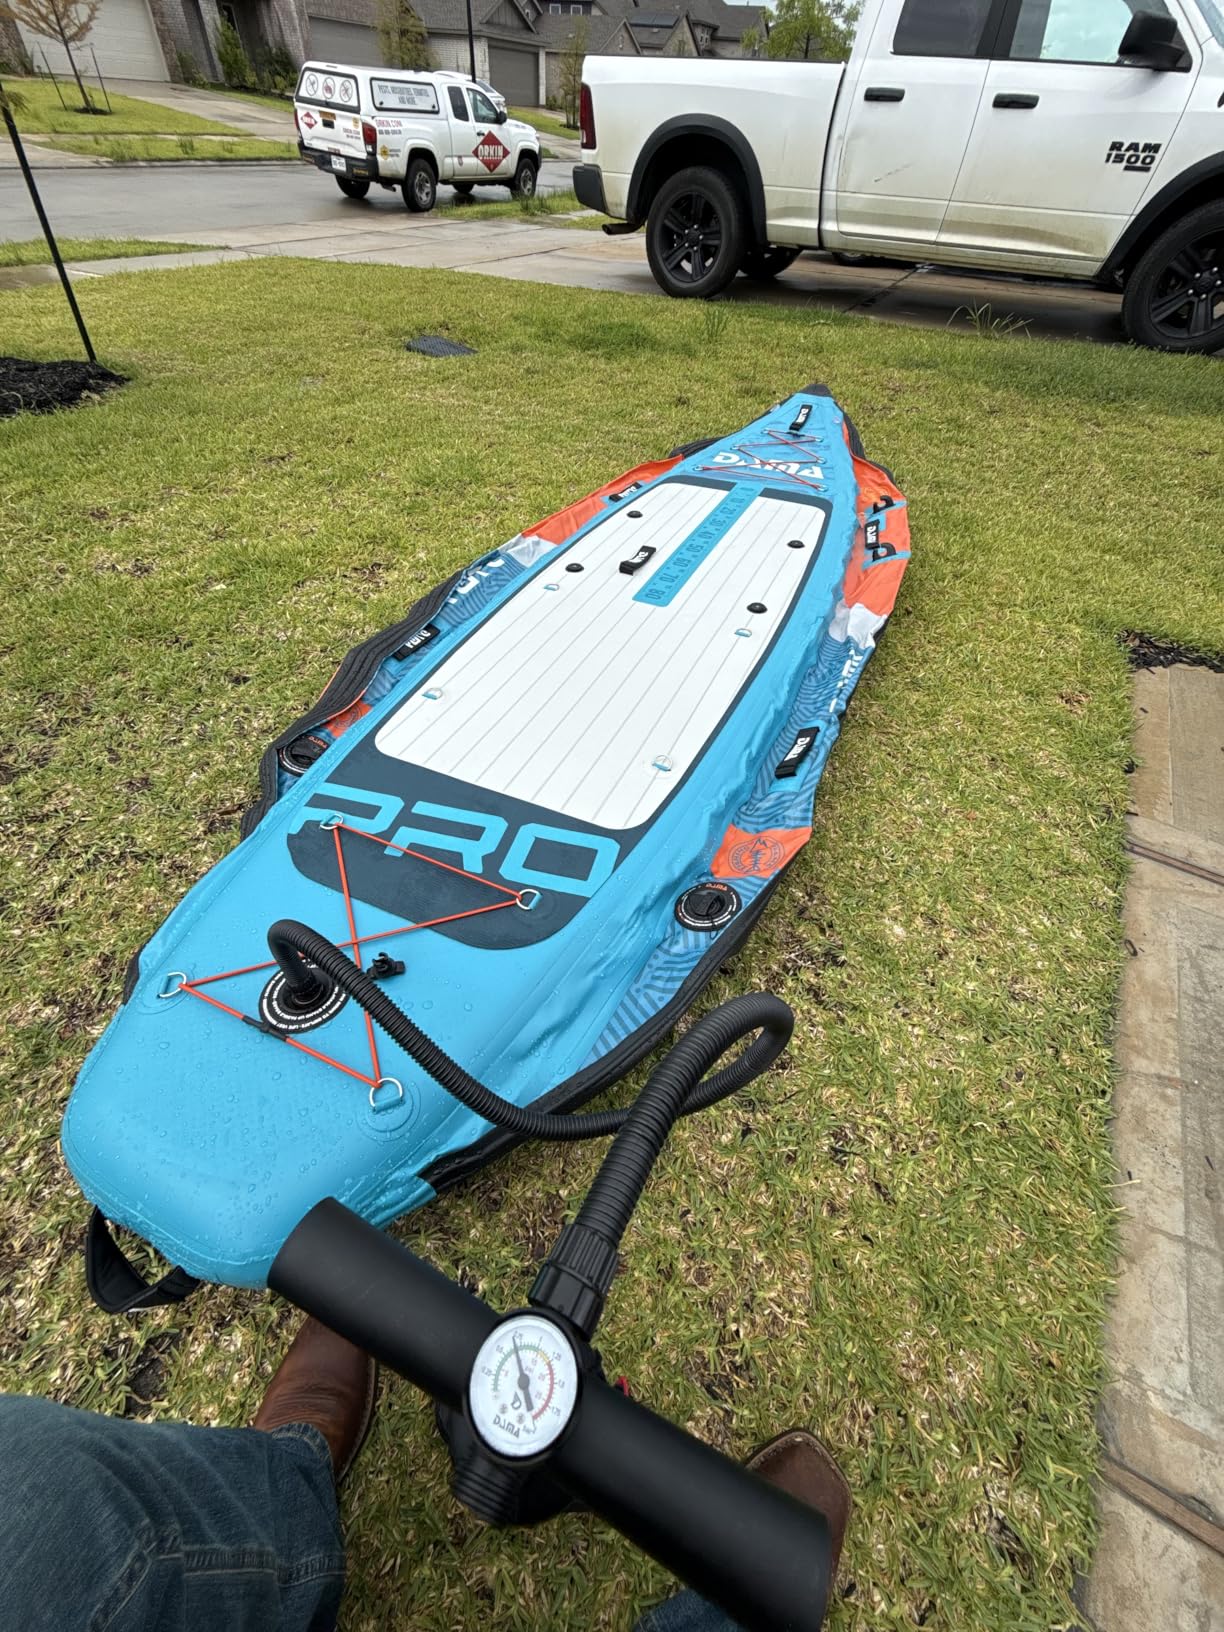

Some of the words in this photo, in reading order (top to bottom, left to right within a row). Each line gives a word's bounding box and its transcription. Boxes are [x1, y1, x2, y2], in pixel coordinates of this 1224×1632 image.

[478, 144, 504, 160] ORKIN
[1109, 141, 1162, 154] RAM
[1104, 152, 1156, 166] 1500
[686, 543, 704, 553] 50
[673, 557, 691, 568] 60
[659, 573, 679, 583] 70
[645, 588, 666, 600] 80
[288, 782, 621, 898] PRO
